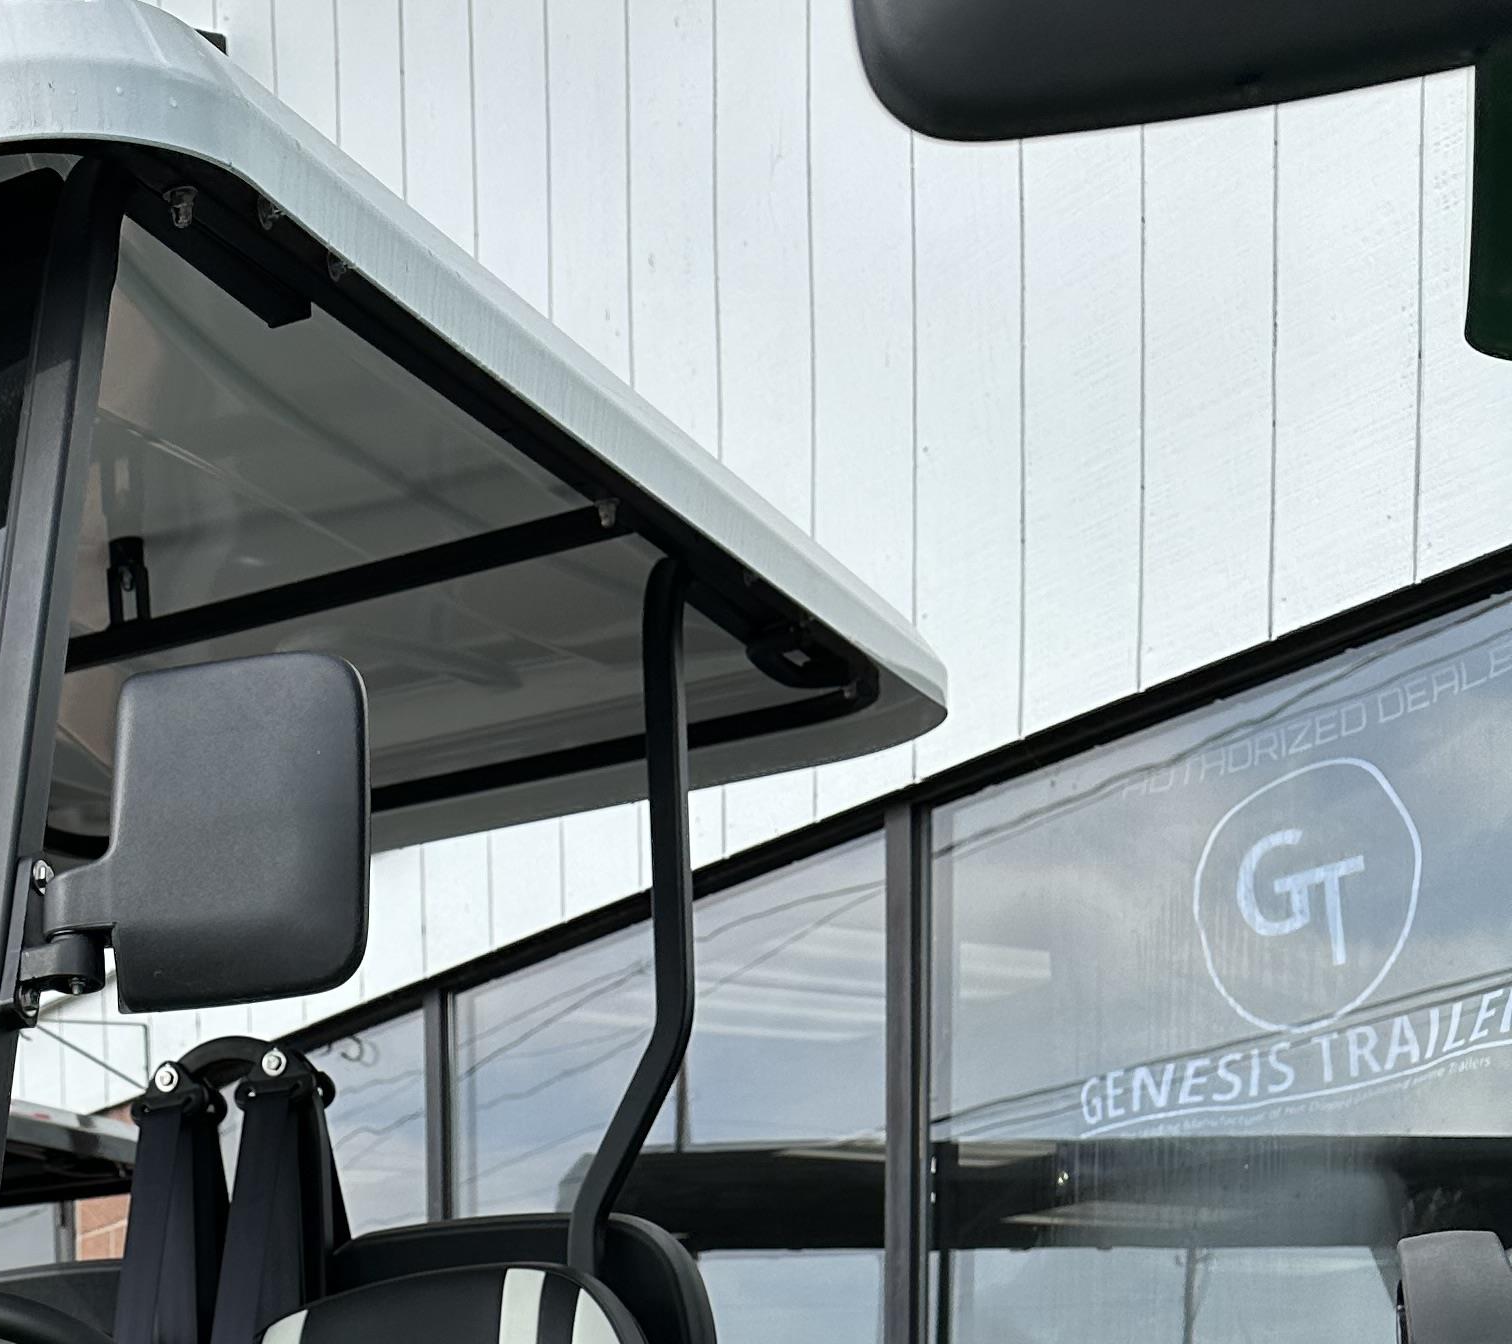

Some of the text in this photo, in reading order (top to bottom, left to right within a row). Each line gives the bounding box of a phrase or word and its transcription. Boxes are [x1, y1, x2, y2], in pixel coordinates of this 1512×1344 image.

[1122, 700, 1366, 801] AUTHORIZED
[1236, 828, 1365, 967] GT
[1080, 1041, 1296, 1125] GENESIS
